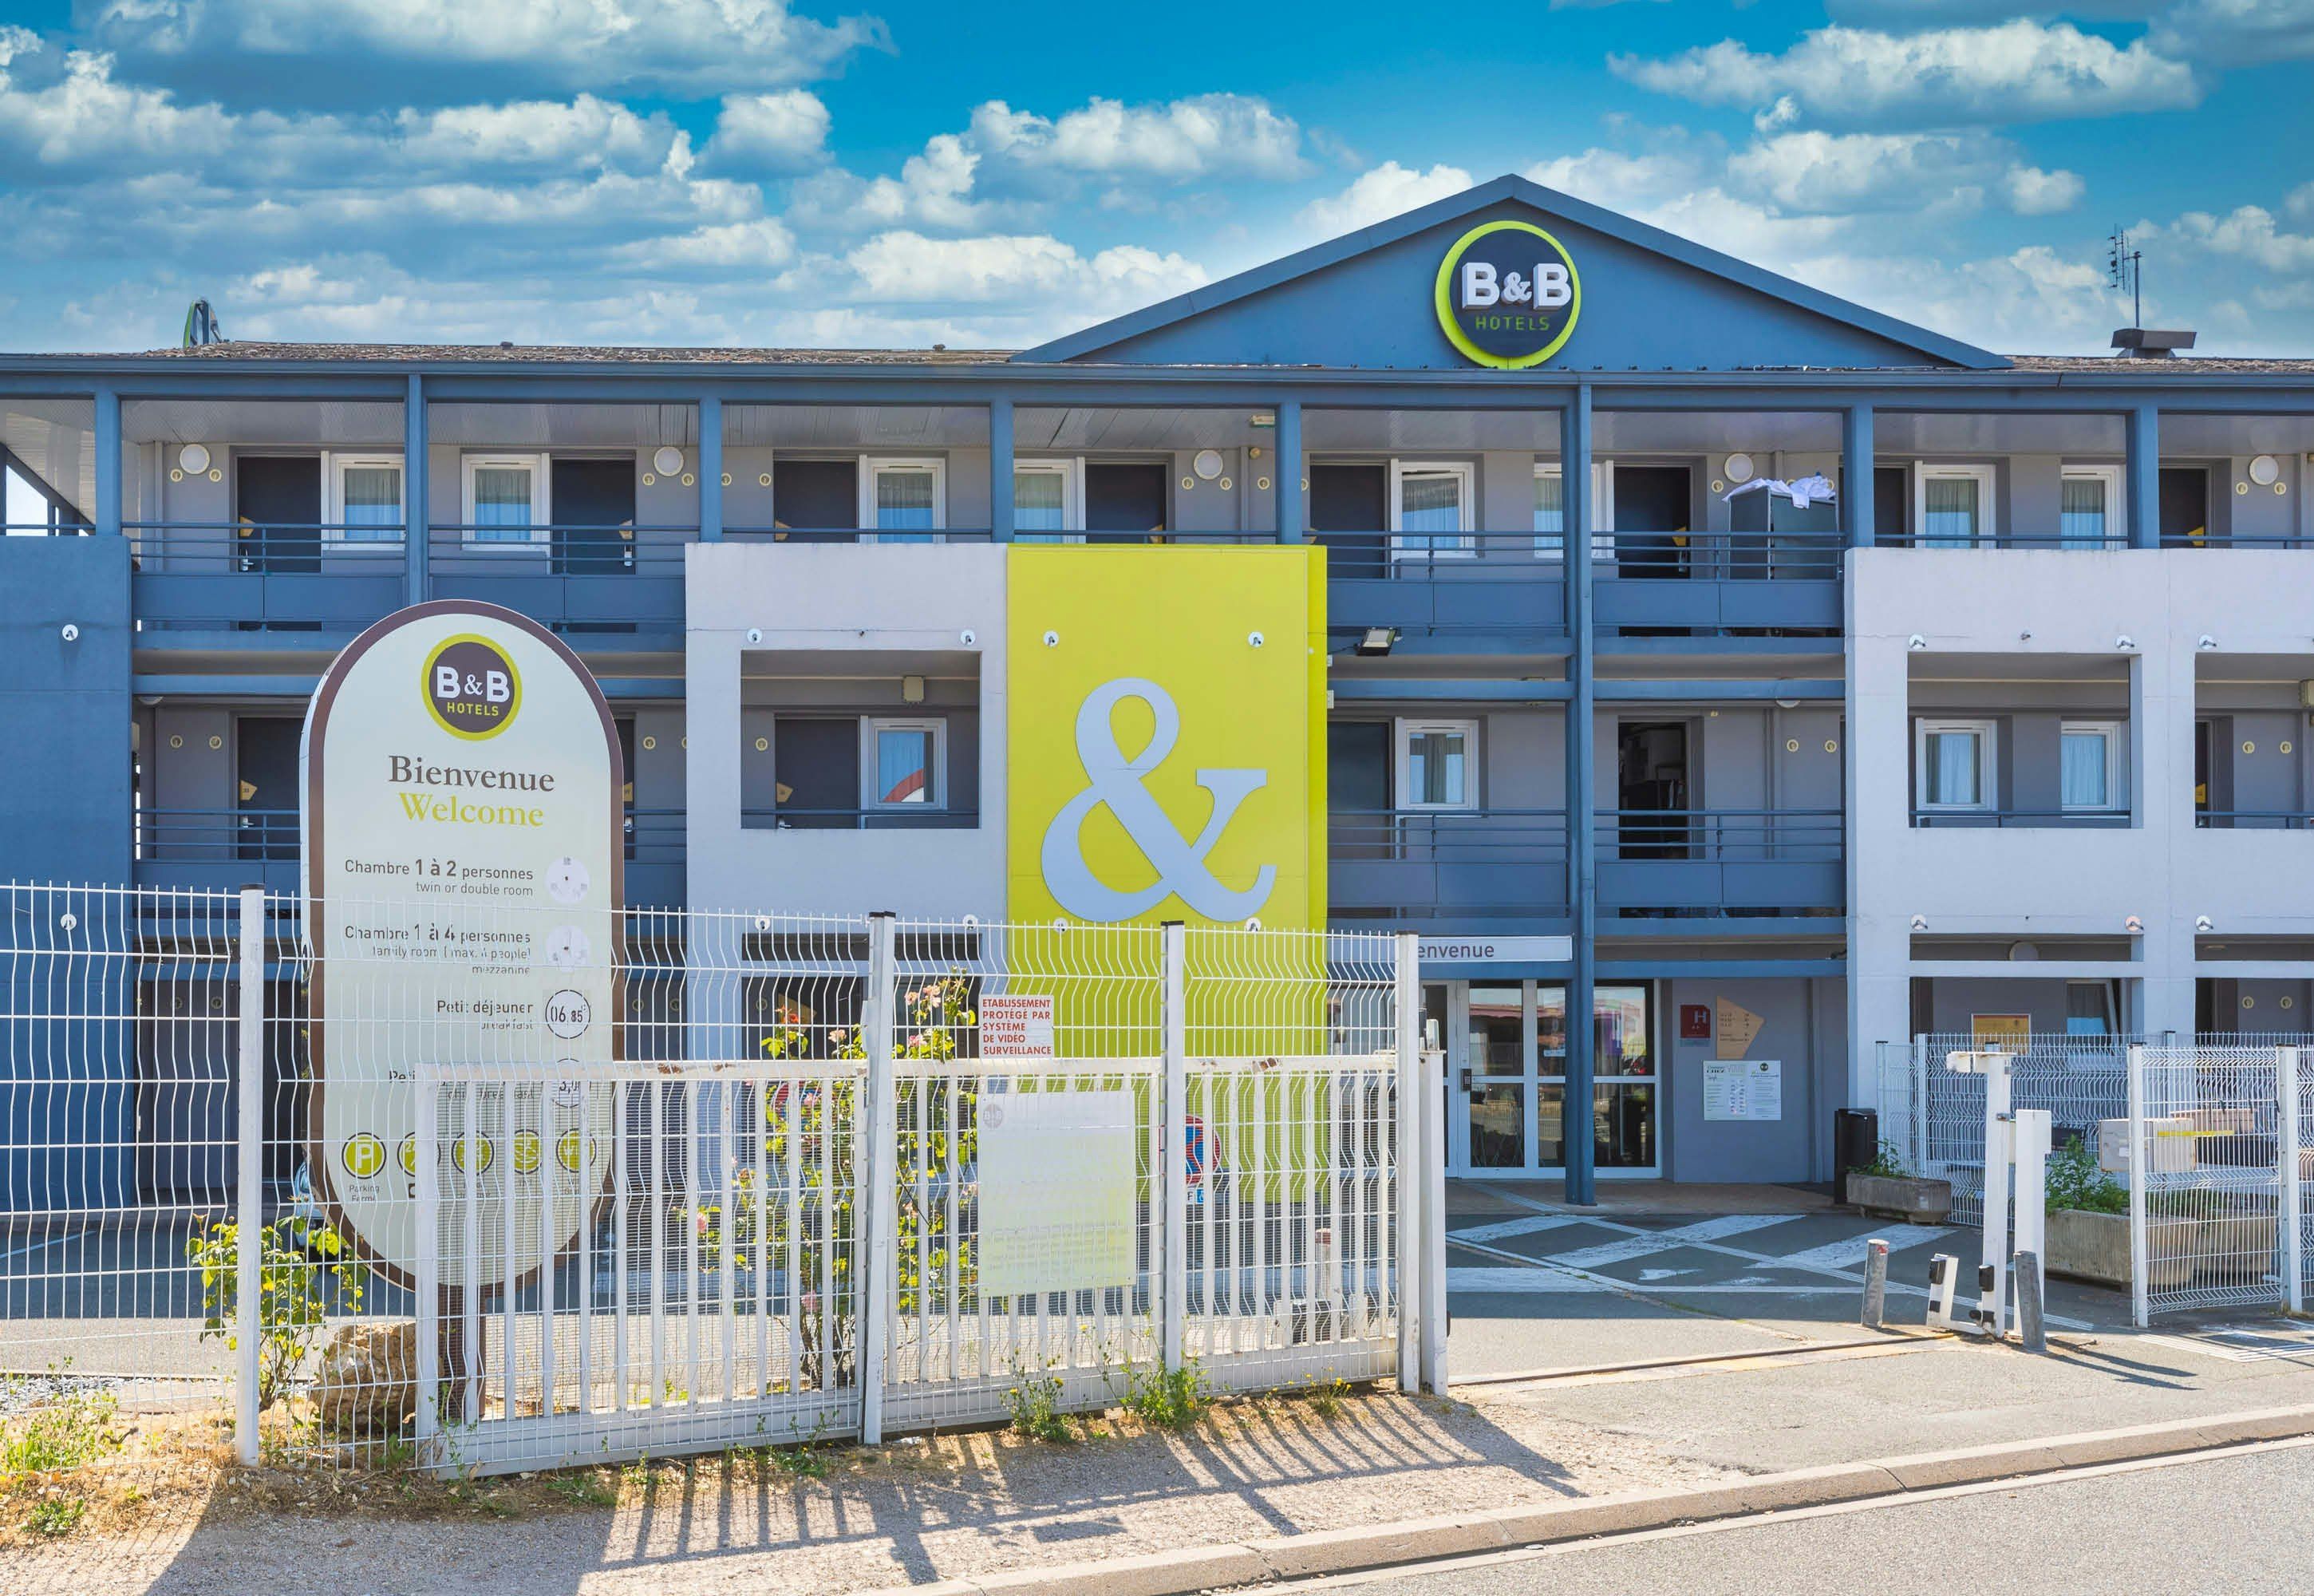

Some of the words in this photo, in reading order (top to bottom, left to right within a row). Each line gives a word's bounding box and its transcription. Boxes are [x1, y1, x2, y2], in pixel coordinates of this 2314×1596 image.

[1462, 263, 1572, 310] B&B
[1476, 316, 1550, 330] HOTELS
[436, 666, 510, 703] B&B
[447, 701, 500, 717] HOTELS
[389, 755, 555, 792] Bienvenue
[1041, 677, 1277, 923] &
[398, 792, 544, 827] Welcome
[345, 859, 409, 875] Chambre
[415, 859, 422, 875] 1
[430, 858, 440, 876] à
[447, 860, 456, 877] 2
[462, 867, 534, 880] personnes
[415, 881, 440, 892] twin
[444, 884, 457, 894] or
[460, 882, 500, 895] double
[503, 886, 533, 896] room
[345, 926, 409, 940] Chambre
[460, 931, 531, 945] personnes
[1418, 945, 1495, 958] envenue
[473, 999, 533, 1017] déjeuner
[983, 1009, 1028, 1019] PROTÉGÉ
[1694, 1010, 1707, 1023] H
[983, 1021, 1026, 1031] SYSTÈME
[998, 1032, 1025, 1043] VIDÉO
[389, 1070, 415, 1083] Peti
